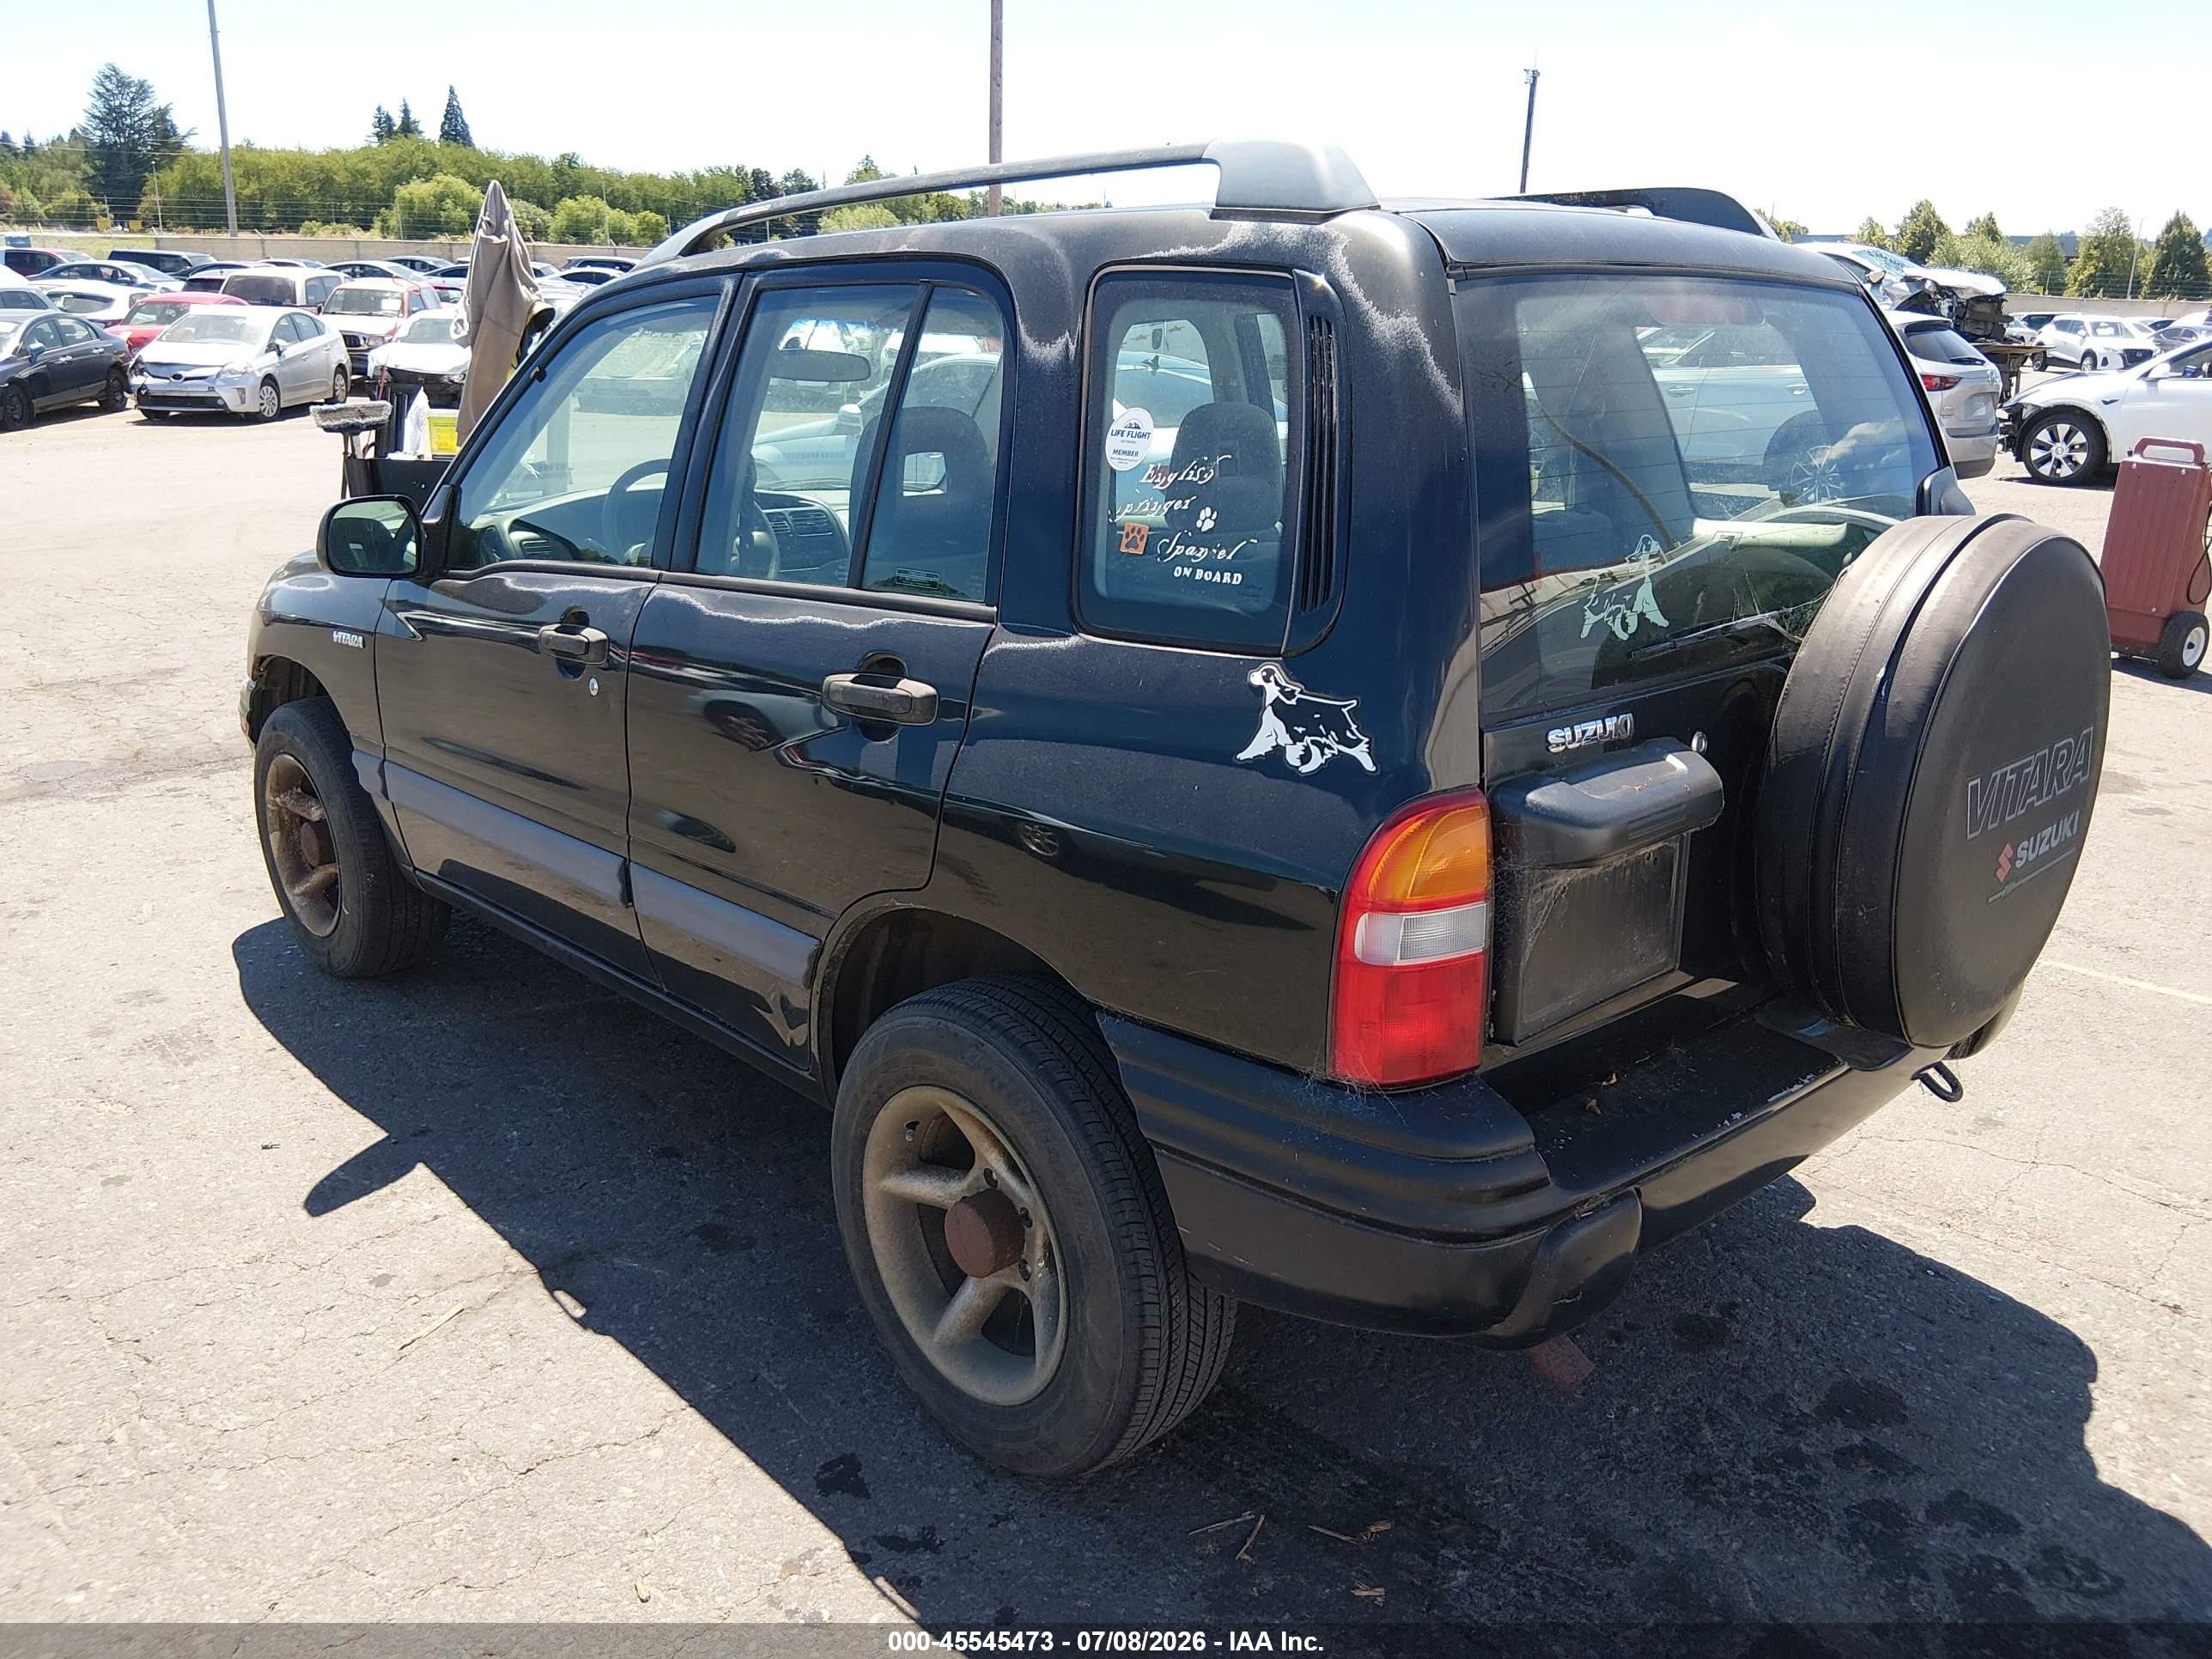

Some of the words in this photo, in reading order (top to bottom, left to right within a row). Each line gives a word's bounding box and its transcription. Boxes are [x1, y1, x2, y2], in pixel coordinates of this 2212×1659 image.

[1127, 430, 1152, 440] FLIGHT
[1112, 448, 1139, 458] MEMBER
[1173, 566, 1193, 578] ON
[1194, 568, 1243, 585] BOARD
[1547, 713, 1634, 753] SUZUKI
[1966, 726, 2094, 840] VITARA
[2014, 810, 2081, 869] SUZUKI
